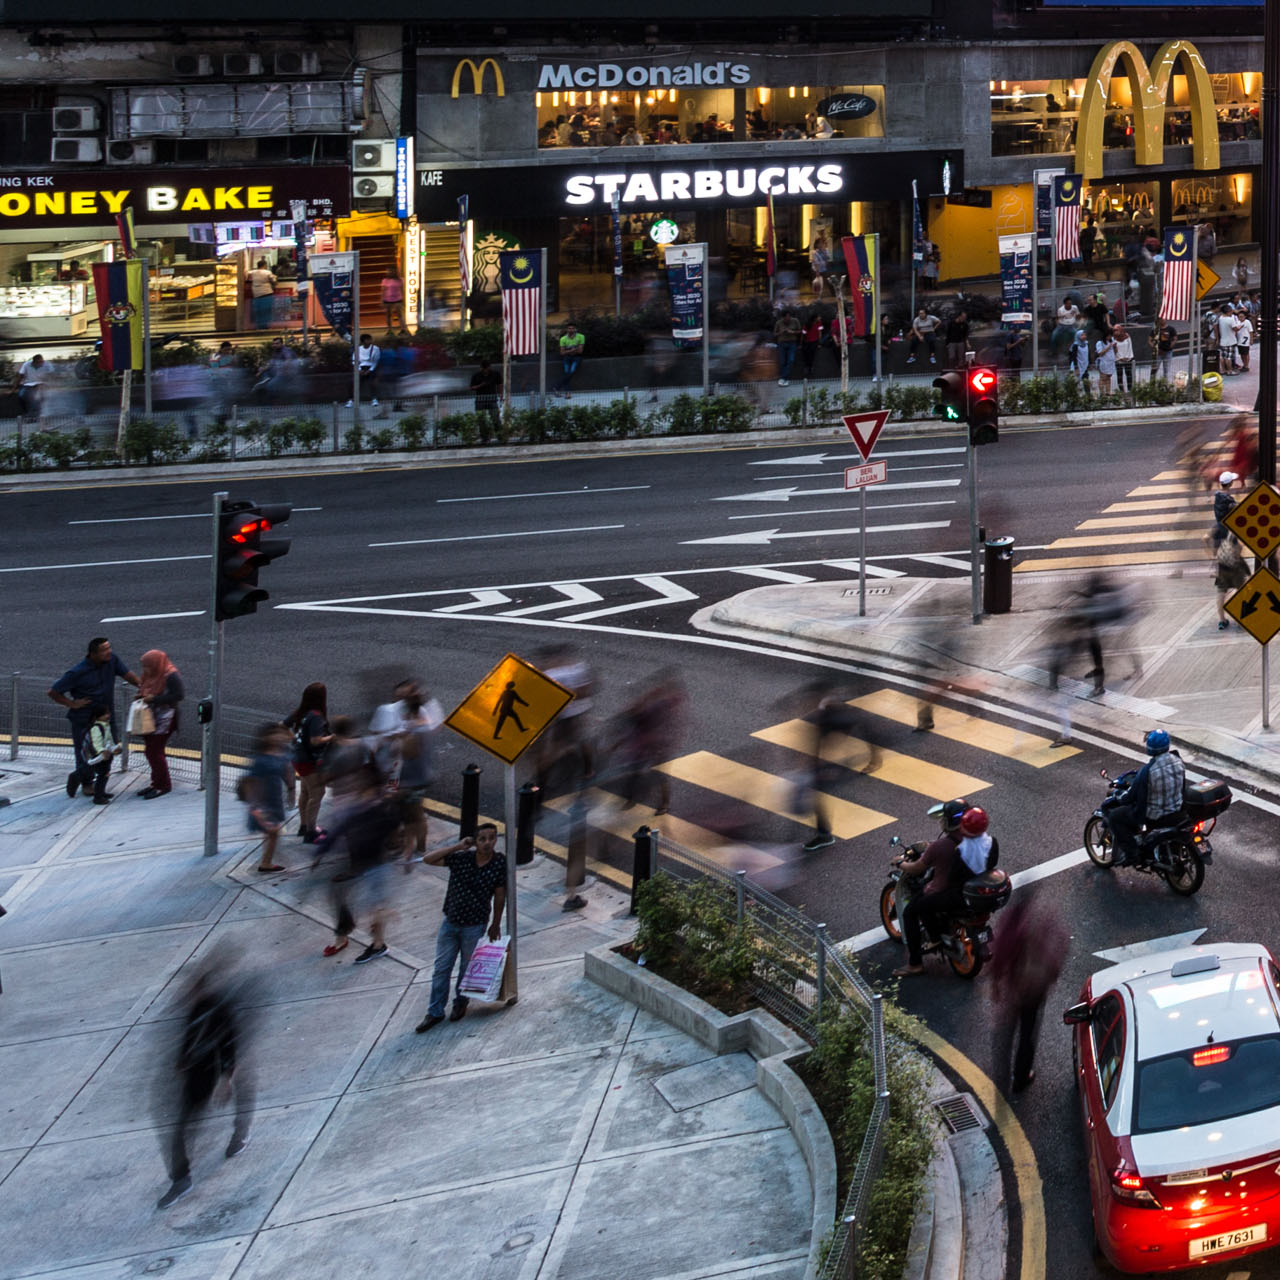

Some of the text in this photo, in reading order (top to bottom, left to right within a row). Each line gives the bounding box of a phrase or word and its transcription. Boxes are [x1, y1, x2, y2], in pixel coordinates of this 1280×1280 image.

[538, 61, 751, 88] McDonald's
[28, 176, 54, 186] KEK
[420, 171, 444, 186] KAFE
[566, 165, 844, 205] STARBUCKS
[147, 186, 274, 212] BAKE
[408, 271, 418, 313] HOUSE
[1202, 1230, 1254, 1252] HWE 7631
